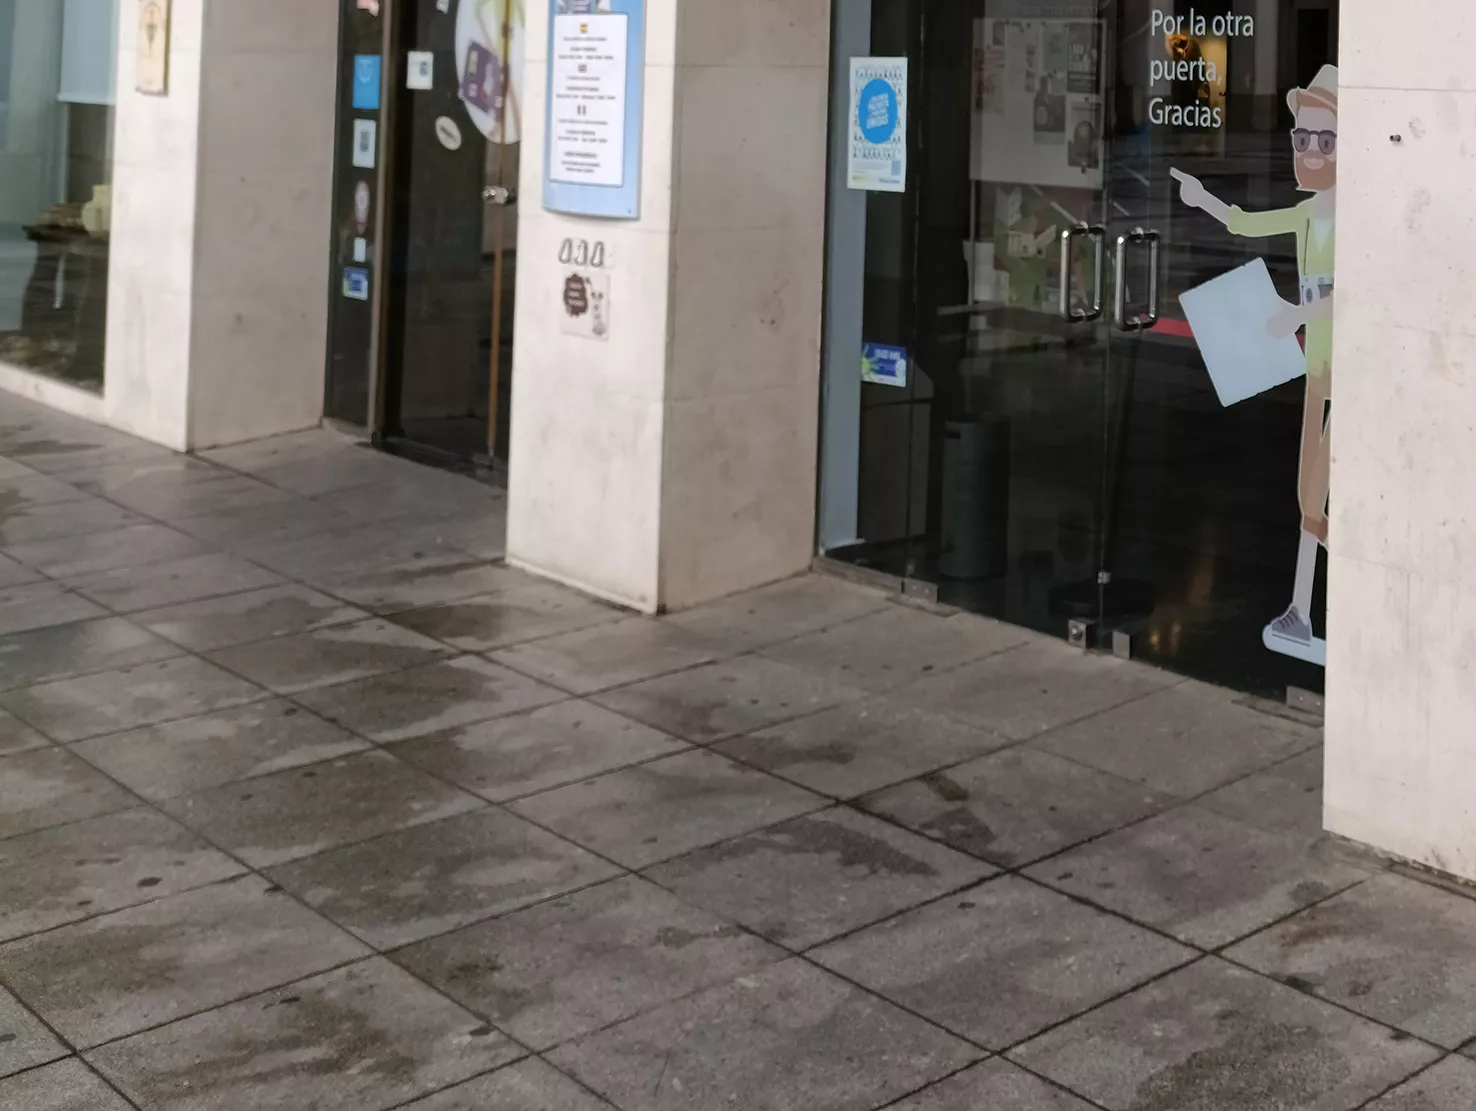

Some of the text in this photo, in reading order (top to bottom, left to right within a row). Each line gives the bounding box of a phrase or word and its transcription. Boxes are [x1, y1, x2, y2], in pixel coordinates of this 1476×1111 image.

[1151, 7, 1255, 37] Por la otra
[1150, 56, 1222, 88] puerta,
[1148, 97, 1222, 129] Gracias
